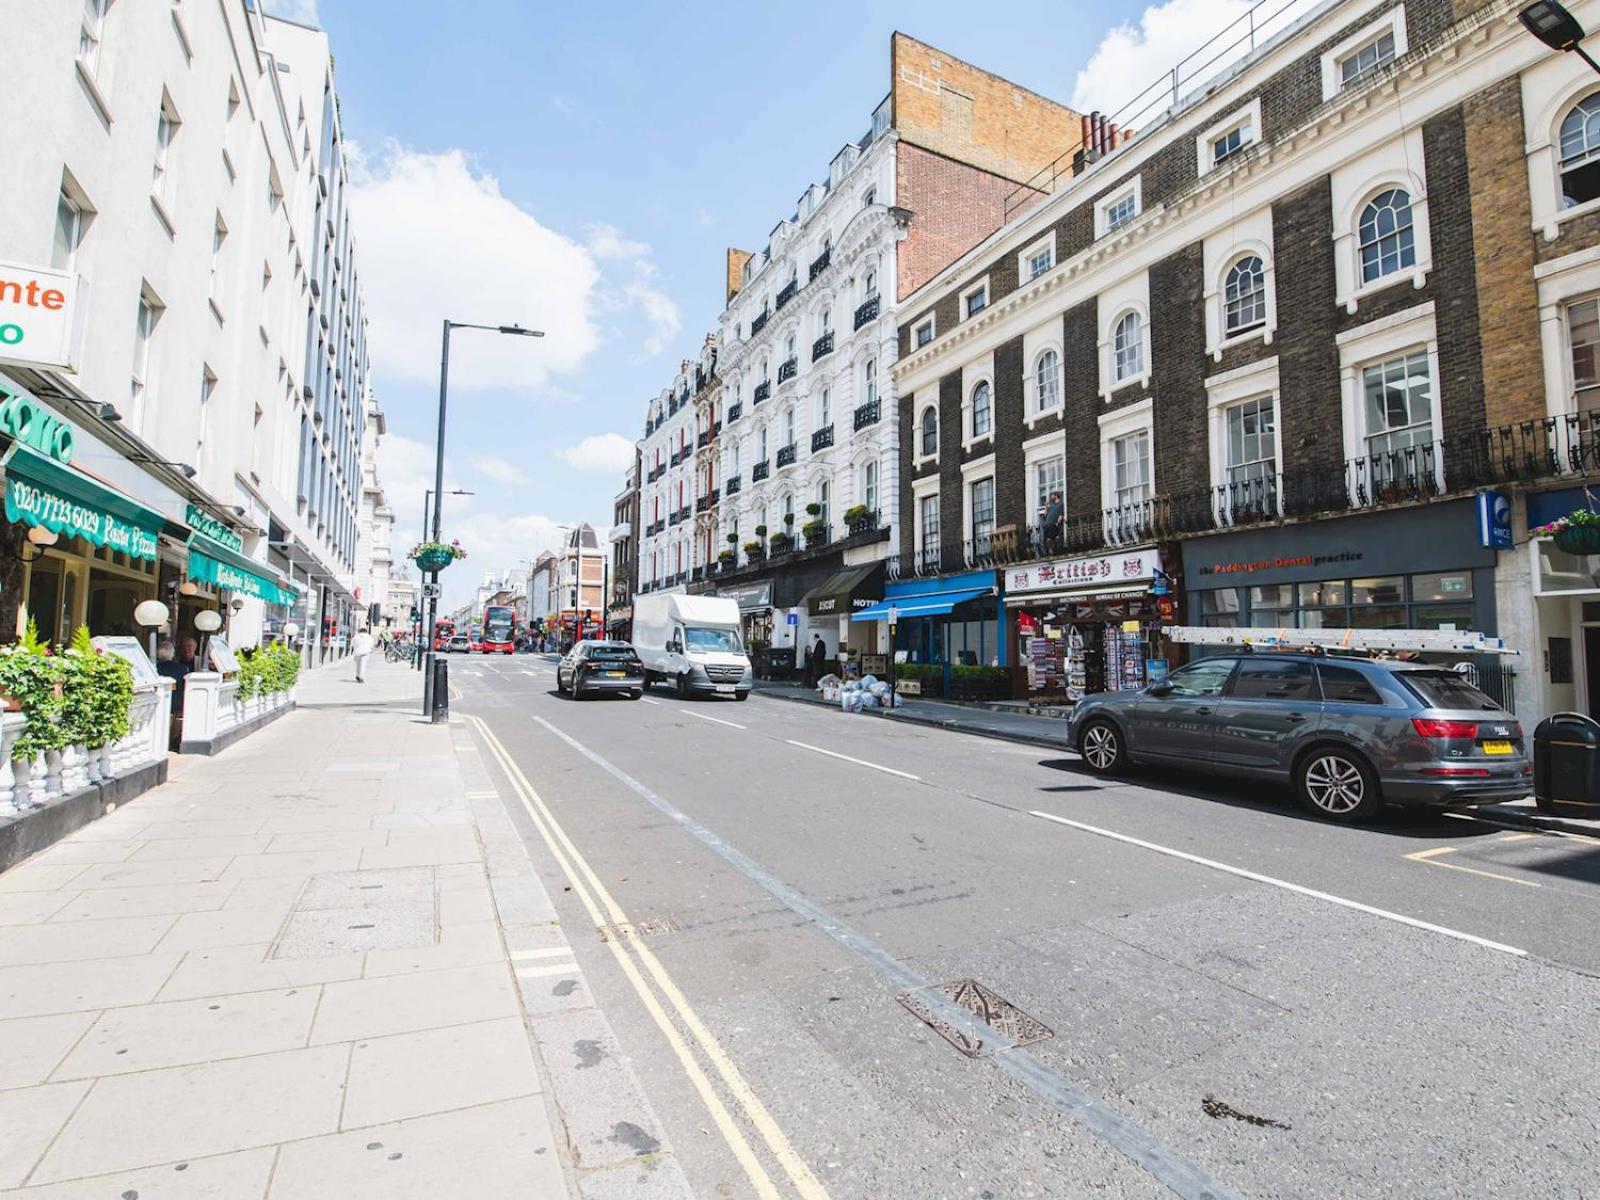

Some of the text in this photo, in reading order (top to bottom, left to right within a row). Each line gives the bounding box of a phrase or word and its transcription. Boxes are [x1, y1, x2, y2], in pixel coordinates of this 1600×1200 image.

[0, 279, 65, 310] nte
[15, 481, 40, 513] 020
[73, 505, 99, 534] 6029
[104, 514, 129, 546] Pasta
[1038, 559, 1112, 583] British
[1275, 555, 1312, 568] Dental
[1314, 551, 1363, 566] practice
[1121, 591, 1143, 599] CHANGE
